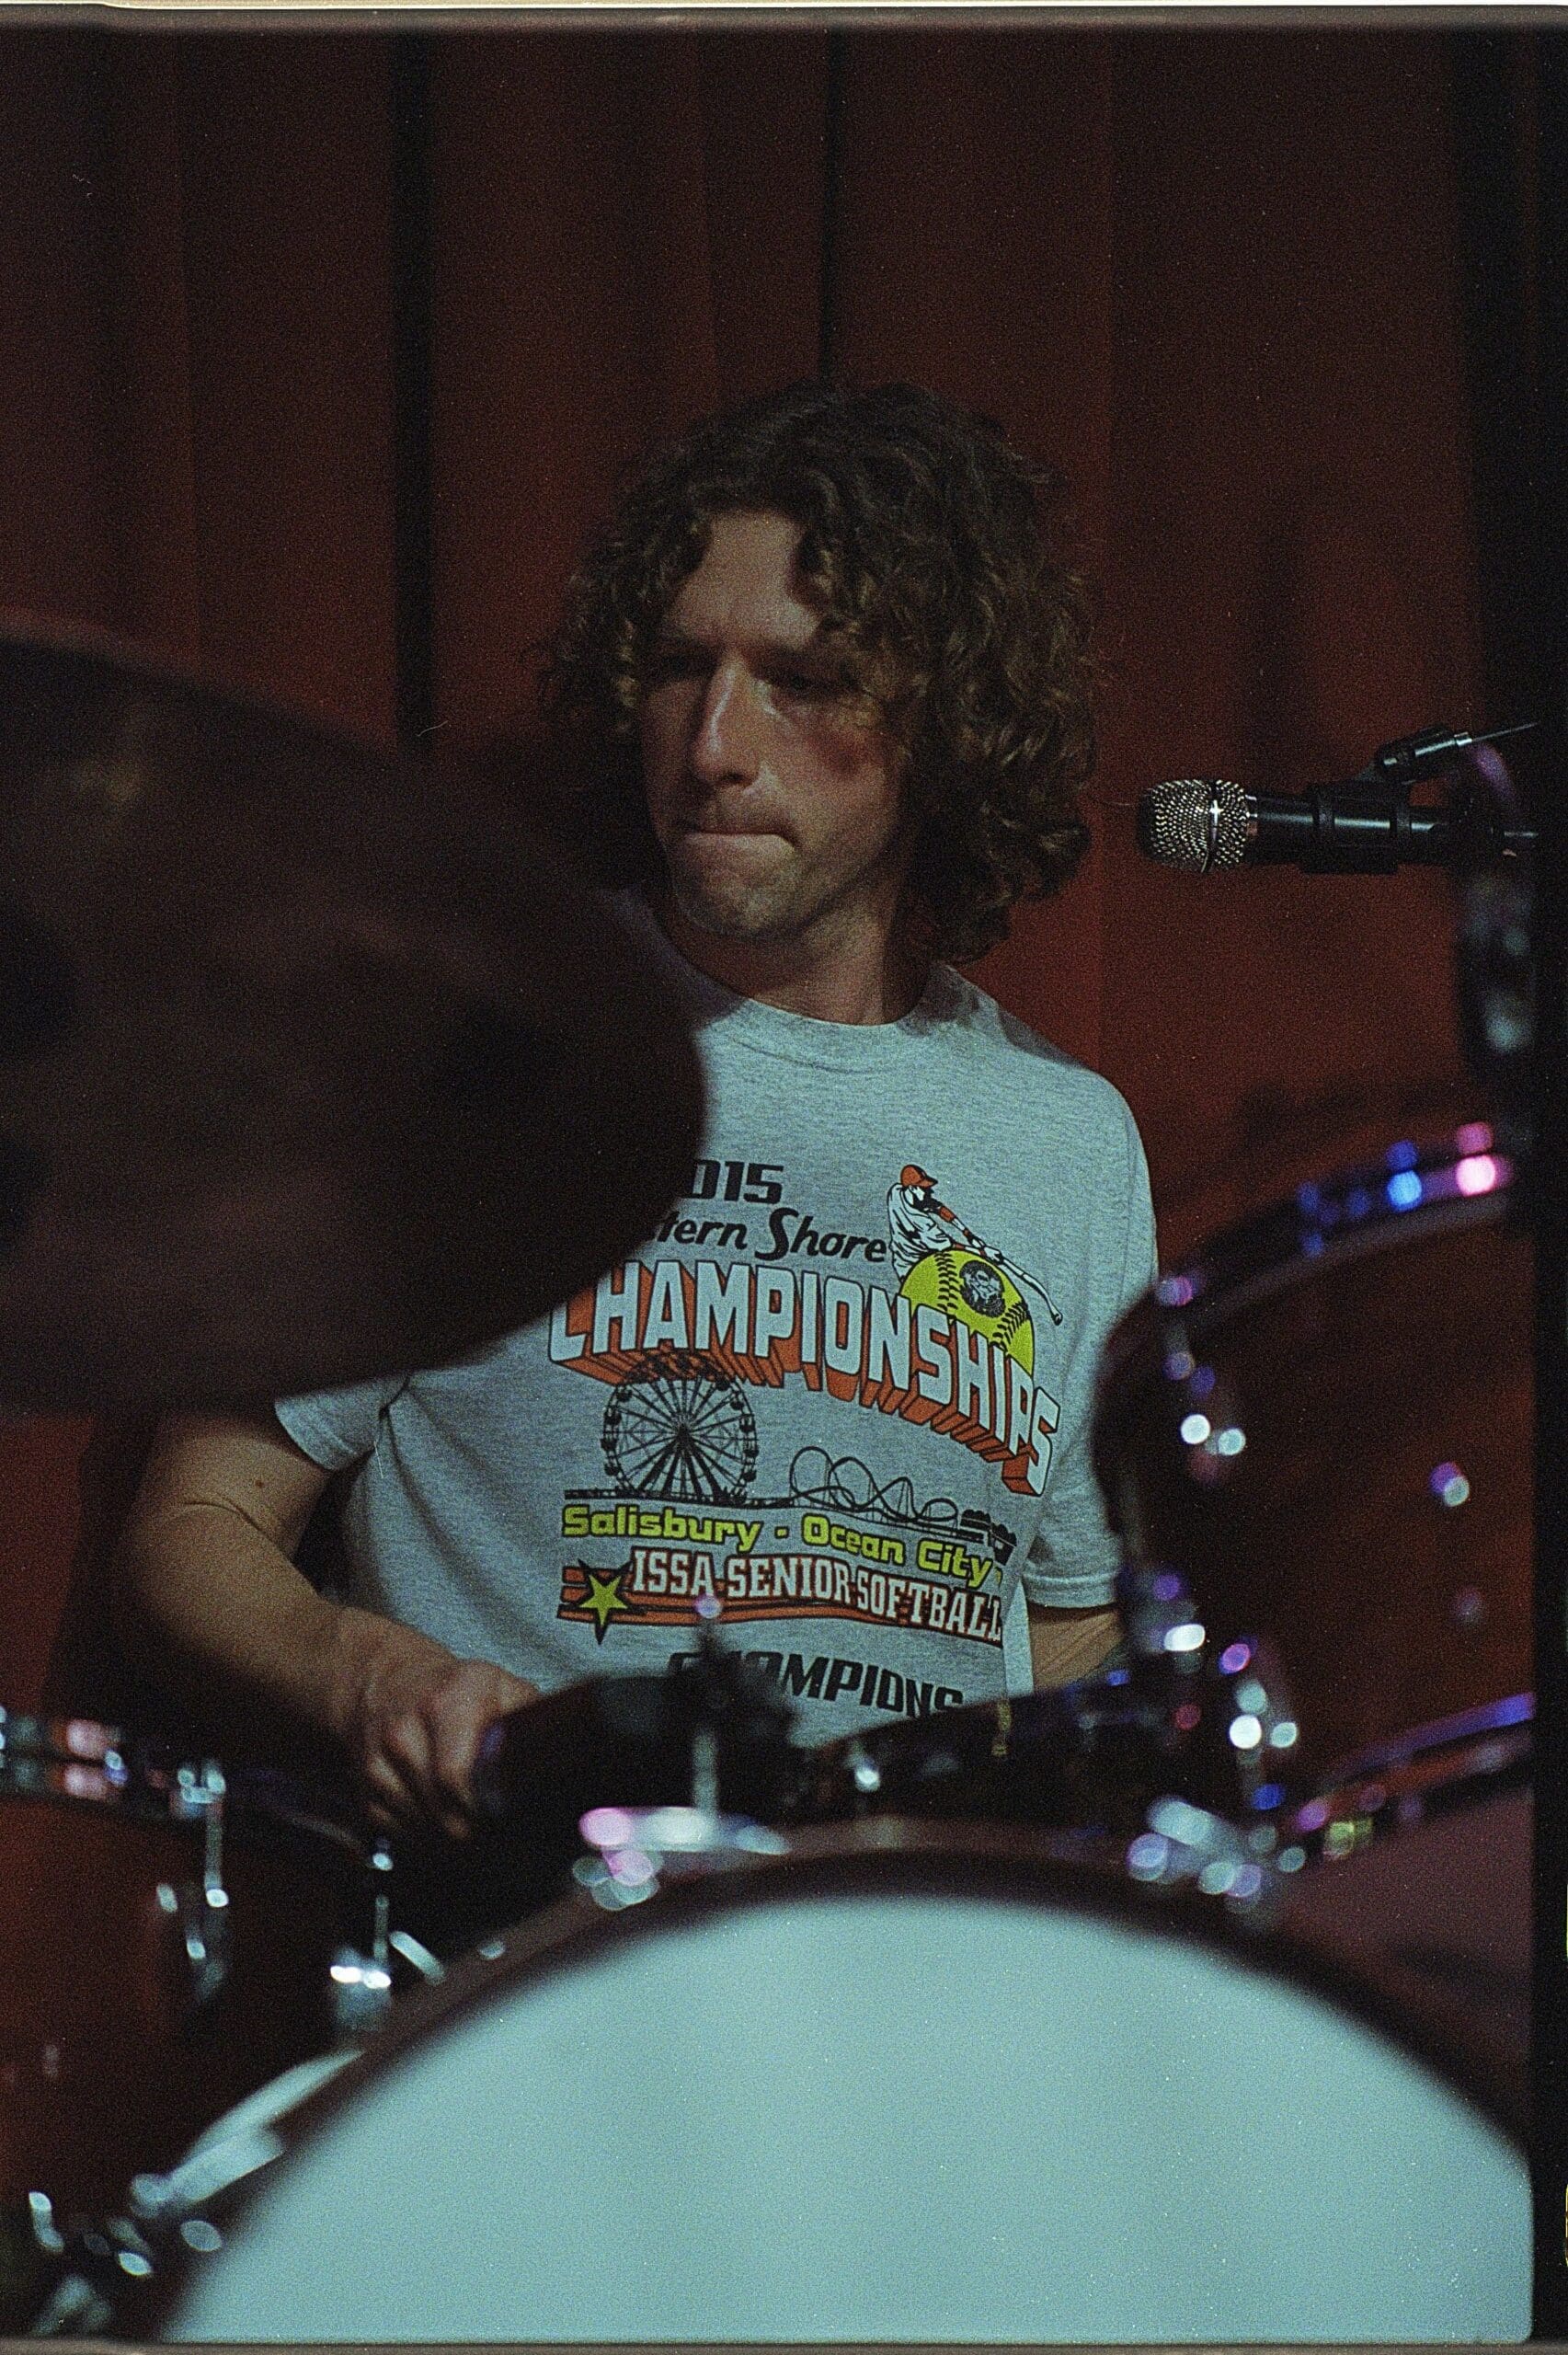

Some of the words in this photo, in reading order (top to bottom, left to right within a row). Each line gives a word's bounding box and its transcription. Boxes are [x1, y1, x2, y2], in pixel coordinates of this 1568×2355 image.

[684, 1157, 784, 1205] 015
[651, 1210, 748, 1251] tern
[754, 1206, 888, 1263] Shore
[562, 1503, 764, 1553] Salisbury
[801, 1511, 907, 1567] Ocean
[916, 1537, 994, 1589] City
[631, 1546, 716, 1597] ISSA
[726, 1554, 852, 1606] SENIOR
[855, 1566, 1003, 1644] SOFTBALL
